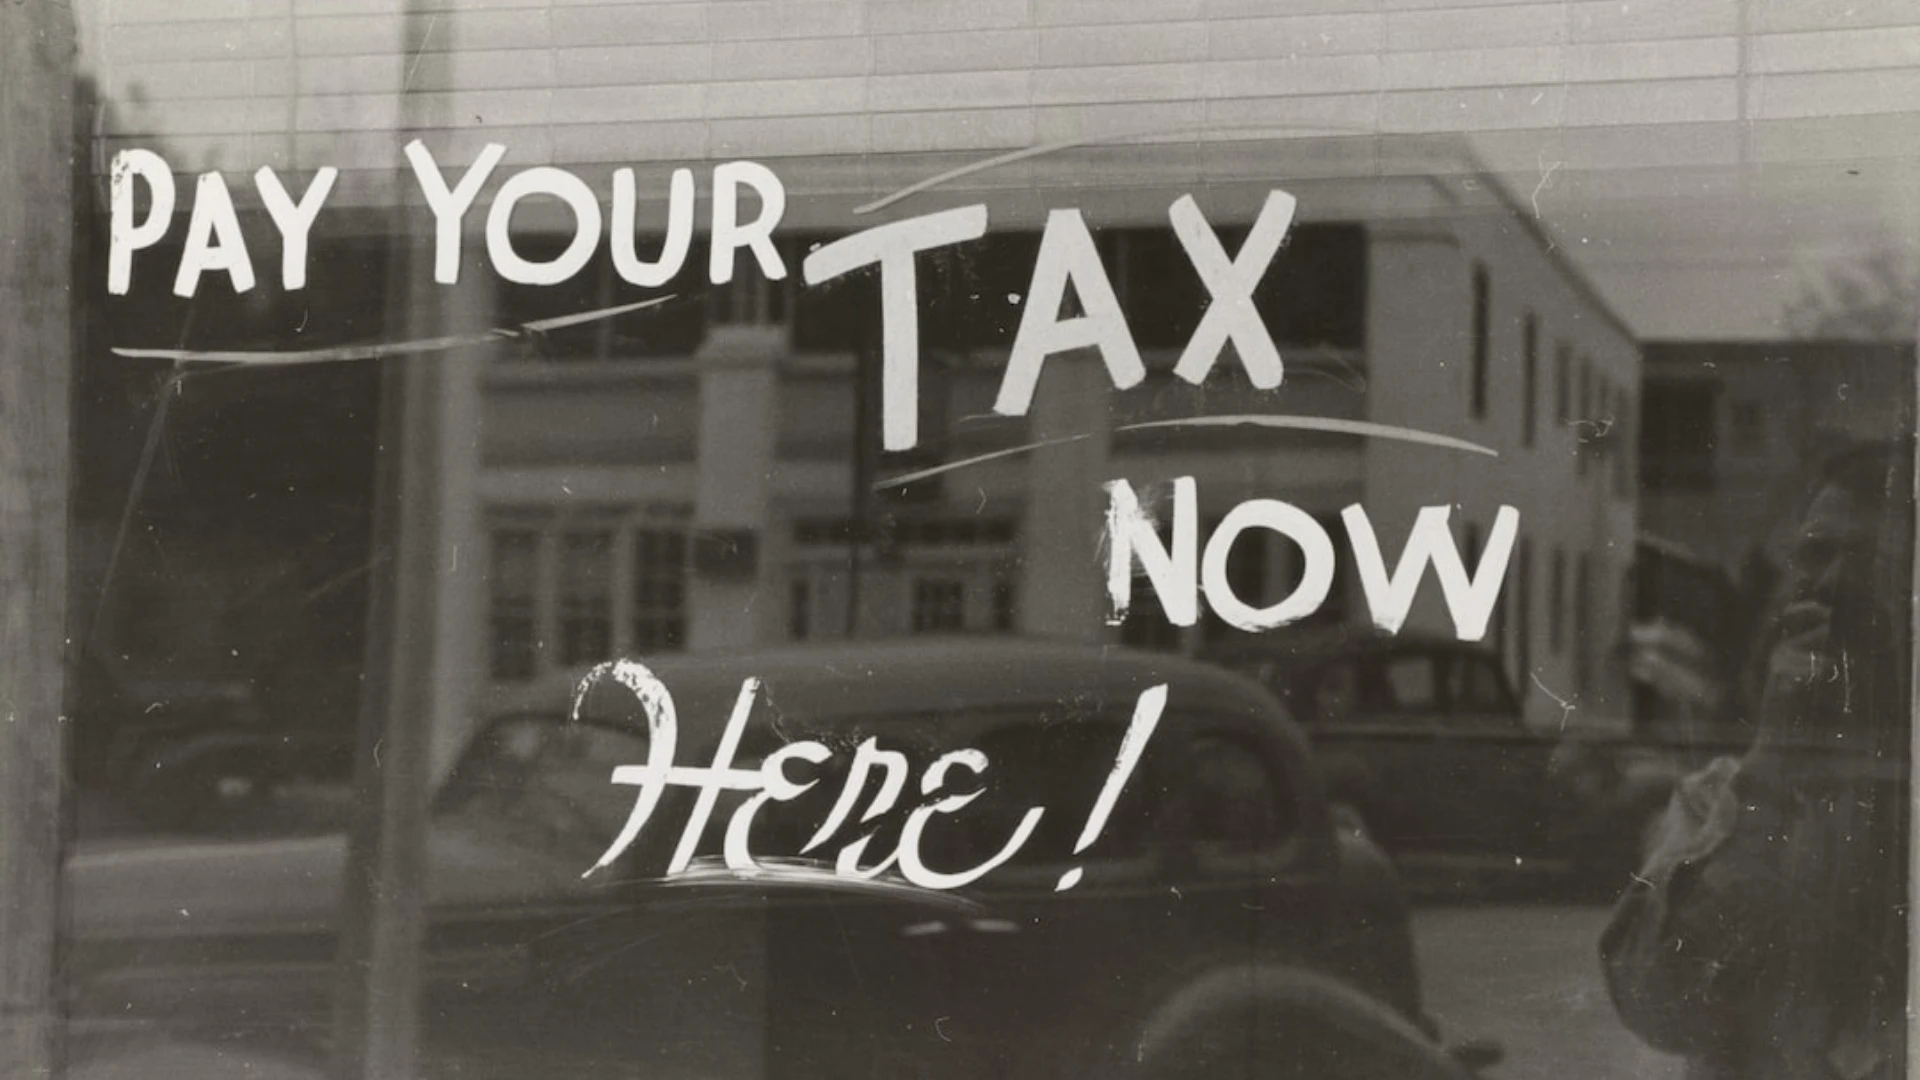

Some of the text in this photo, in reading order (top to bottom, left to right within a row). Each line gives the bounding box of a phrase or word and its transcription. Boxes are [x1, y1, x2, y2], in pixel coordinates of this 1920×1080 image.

[108, 141, 1296, 451] PAY YOUR TAX
[1105, 475, 1519, 641] NOW
